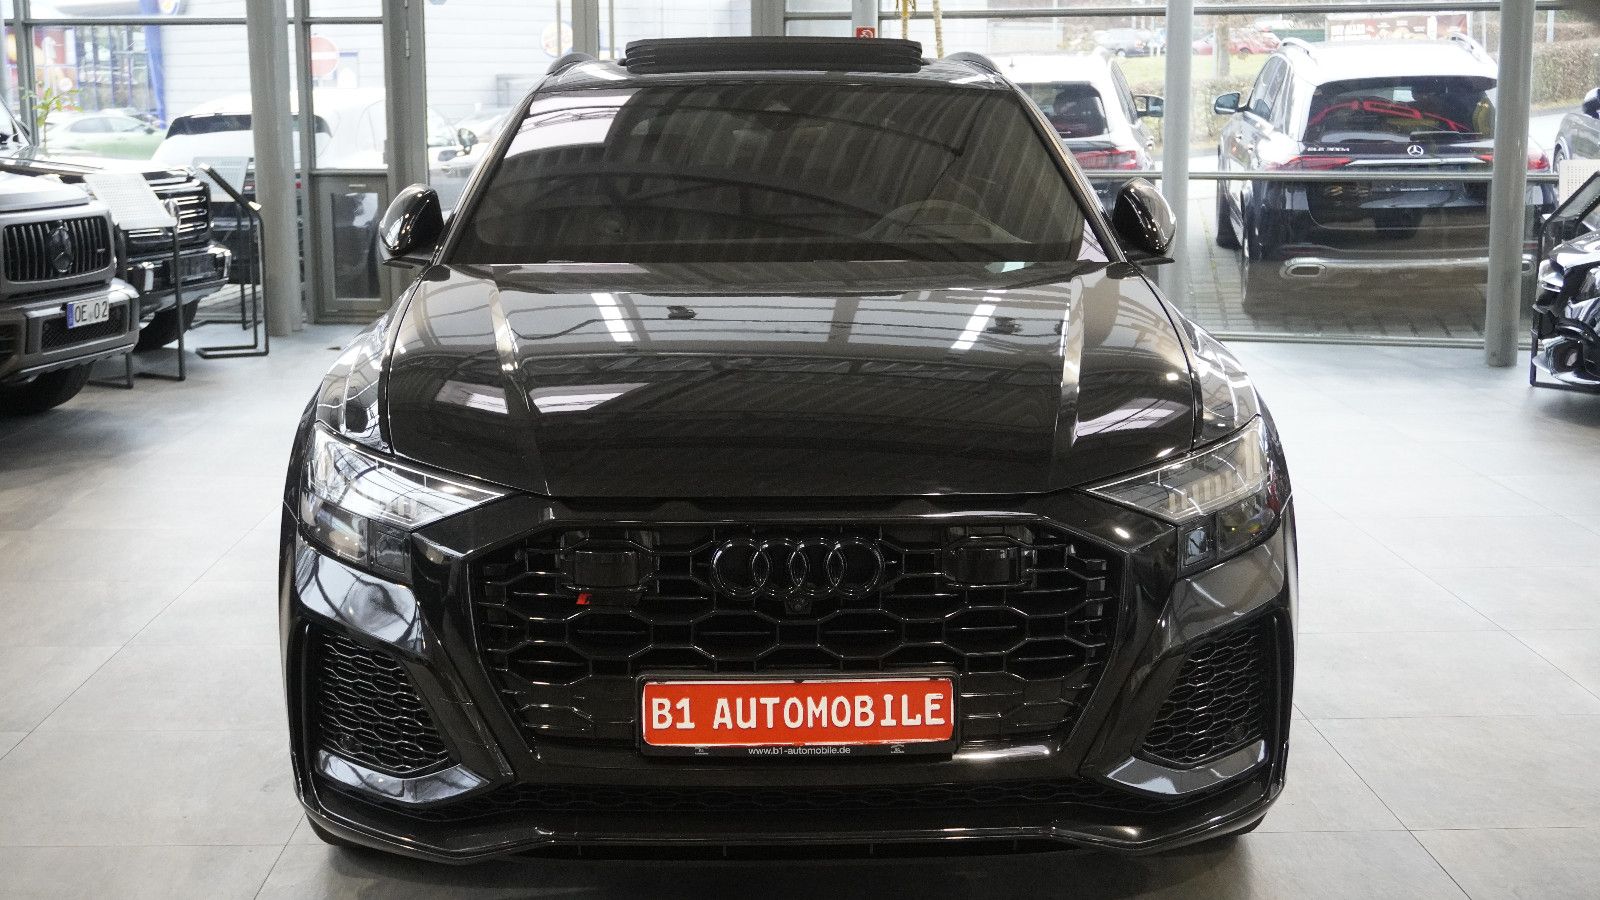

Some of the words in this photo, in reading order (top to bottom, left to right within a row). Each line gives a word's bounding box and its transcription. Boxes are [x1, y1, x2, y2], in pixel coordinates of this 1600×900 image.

[75, 304, 88, 323] OE
[94, 301, 108, 319] 02
[652, 697, 696, 730] B1
[712, 693, 946, 730] AUTOMOBILE
[748, 746, 851, 756] www.b1-automobile.de
